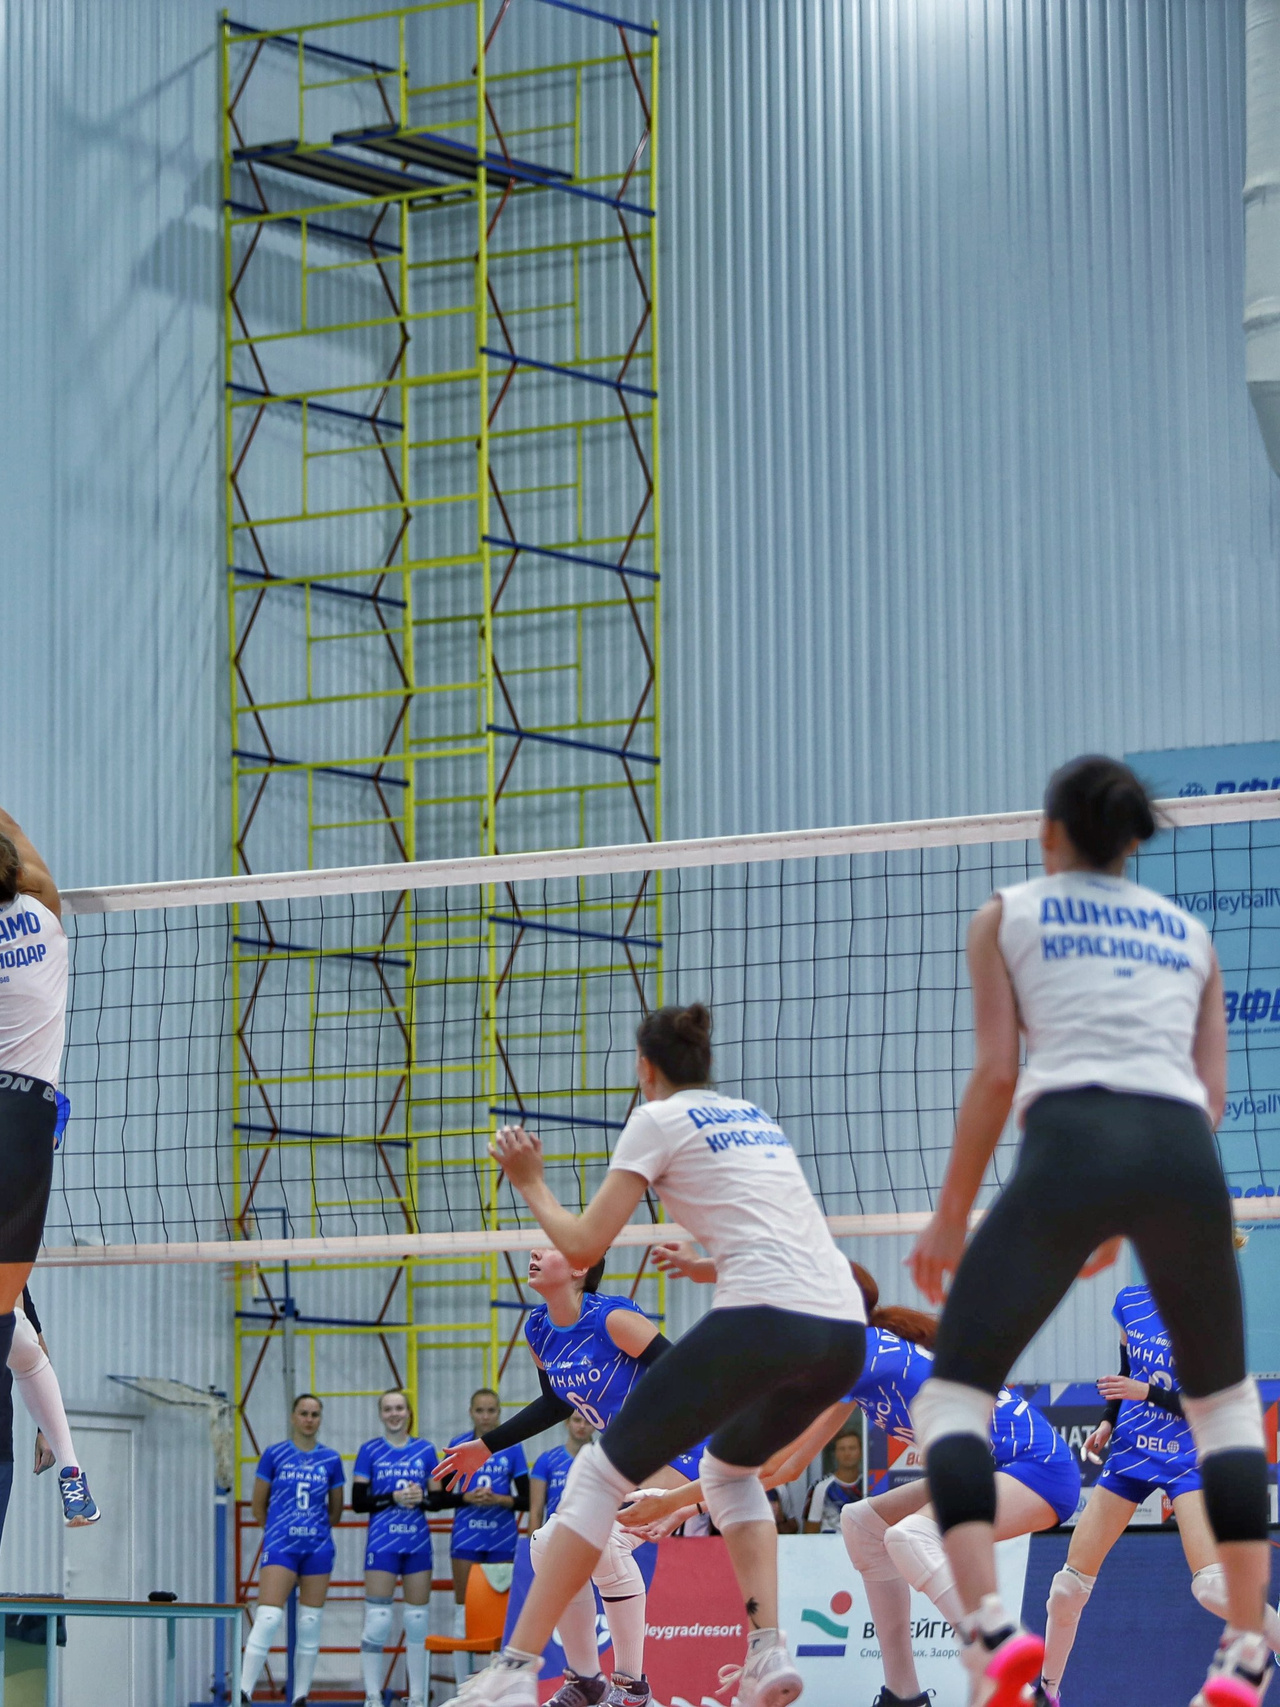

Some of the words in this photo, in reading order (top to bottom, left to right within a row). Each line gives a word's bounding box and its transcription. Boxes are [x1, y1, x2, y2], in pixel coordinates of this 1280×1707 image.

[1040, 896, 1187, 941] ДИНАМО
[1041, 934, 1192, 970] КРАСНОДАР
[549, 1368, 600, 1388] ИНАМО
[566, 1391, 605, 1430] 6
[296, 1482, 310, 1510] 5
